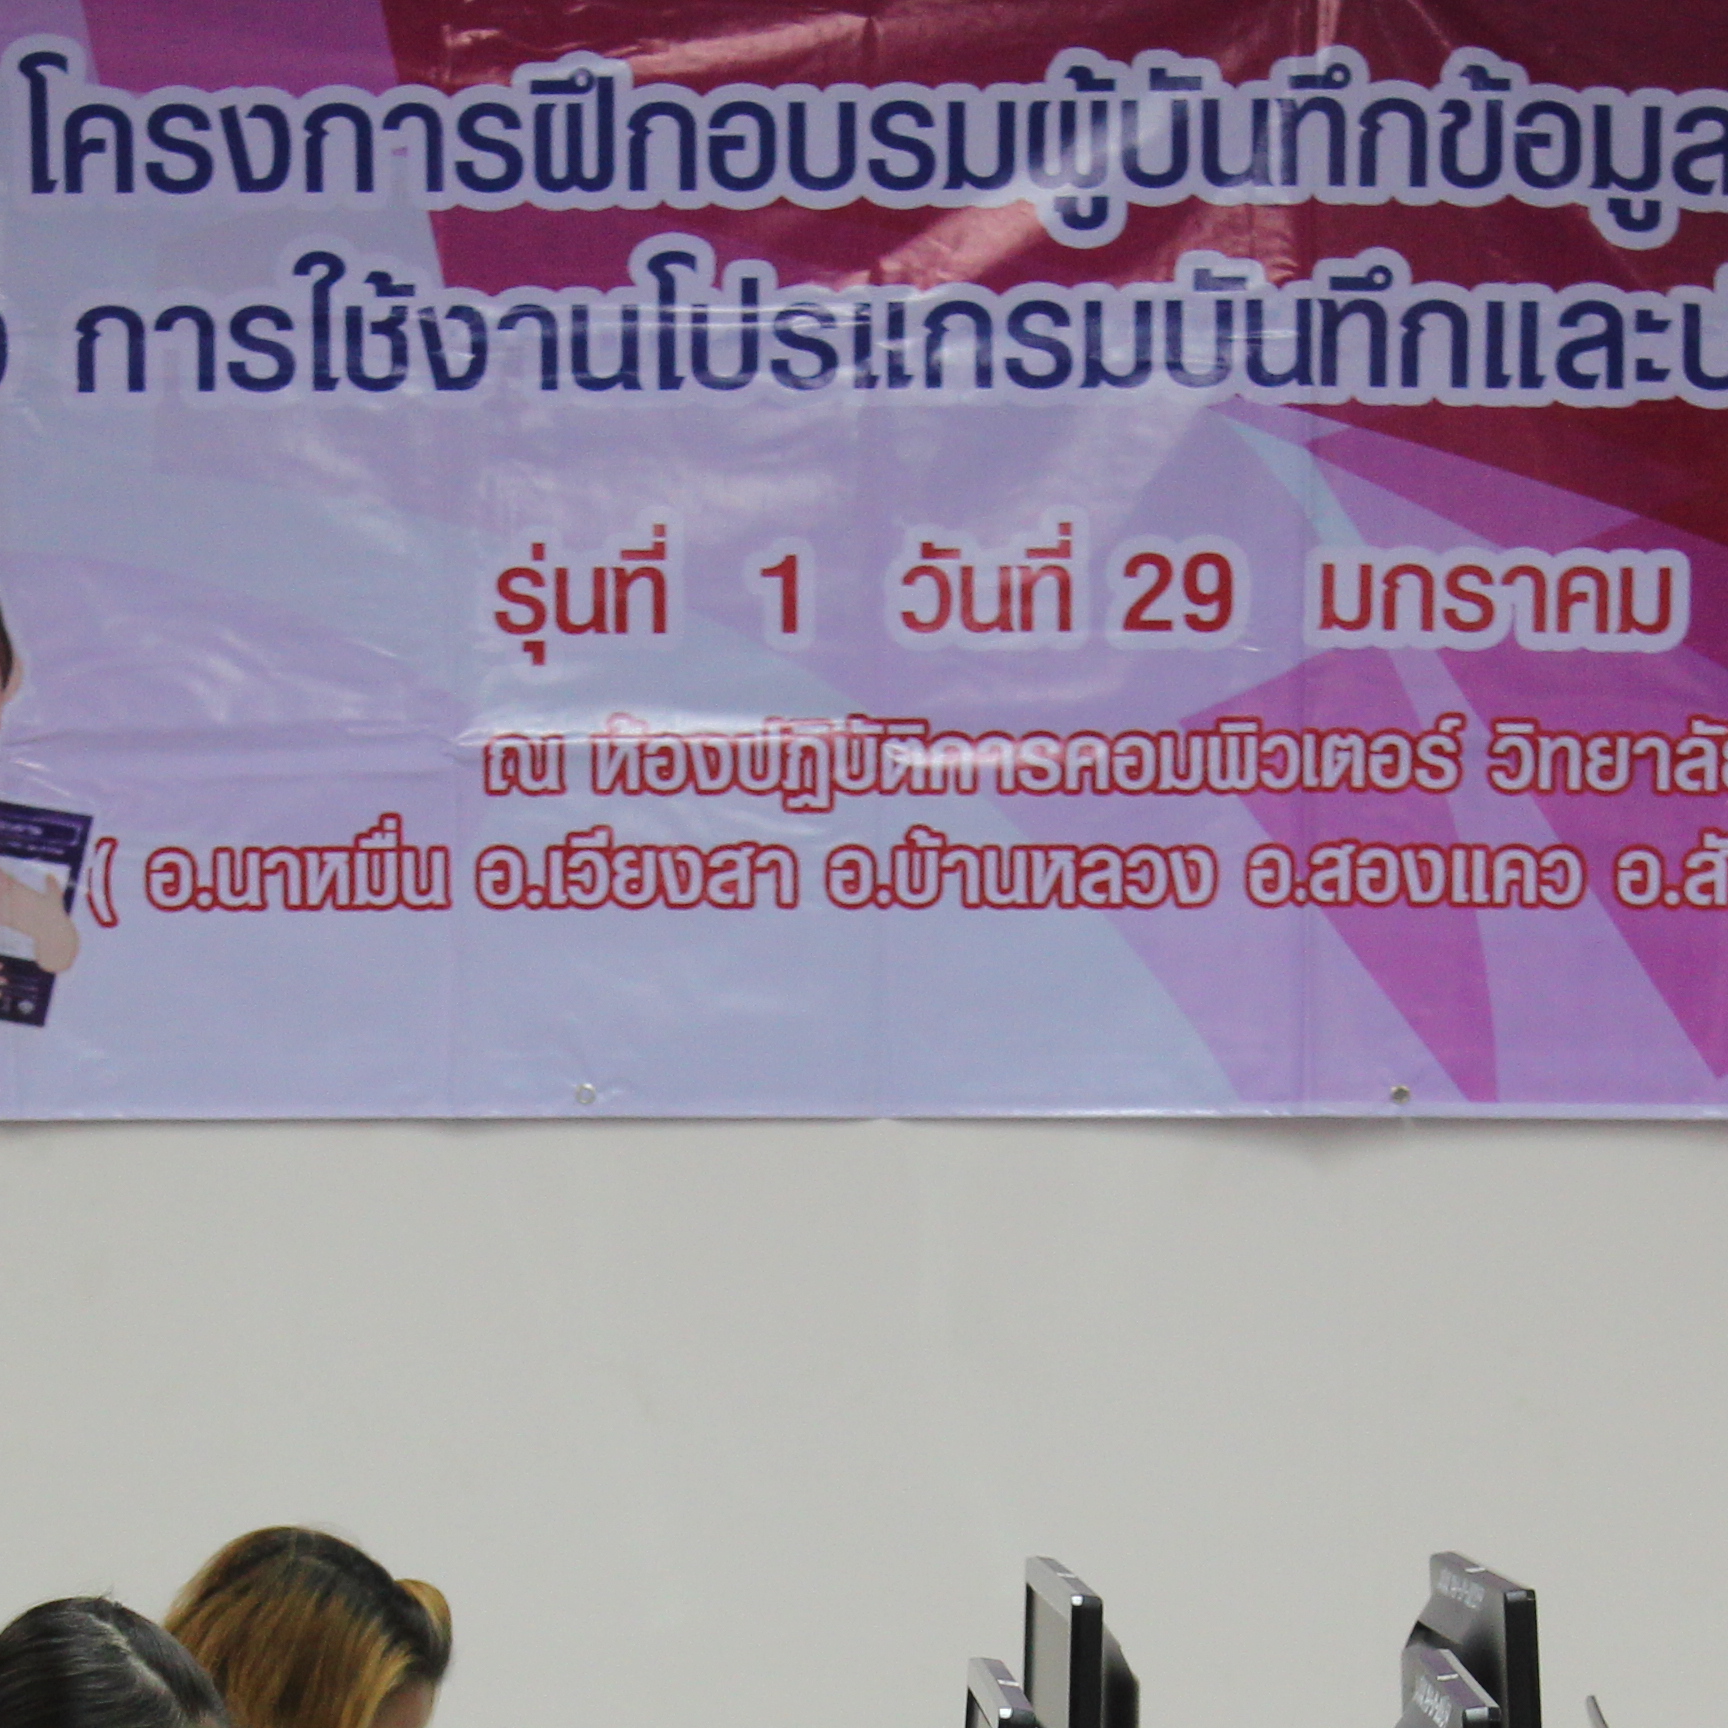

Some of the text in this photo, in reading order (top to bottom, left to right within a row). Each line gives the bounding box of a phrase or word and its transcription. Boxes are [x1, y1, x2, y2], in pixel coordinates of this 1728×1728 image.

[493, 523, 668, 666] รุ่นที่
[759, 555, 801, 634] 1
[900, 522, 1073, 633] วันที่
[1121, 552, 1234, 632] 29
[1318, 560, 1674, 633] มกราคม
[145, 814, 452, 910] อ.นาหมื่น
[475, 826, 799, 910] อ.เวียงสา
[825, 826, 1219, 910] อ.บ้านหลวง
[1245, 839, 1587, 908] อ.สองแคว
